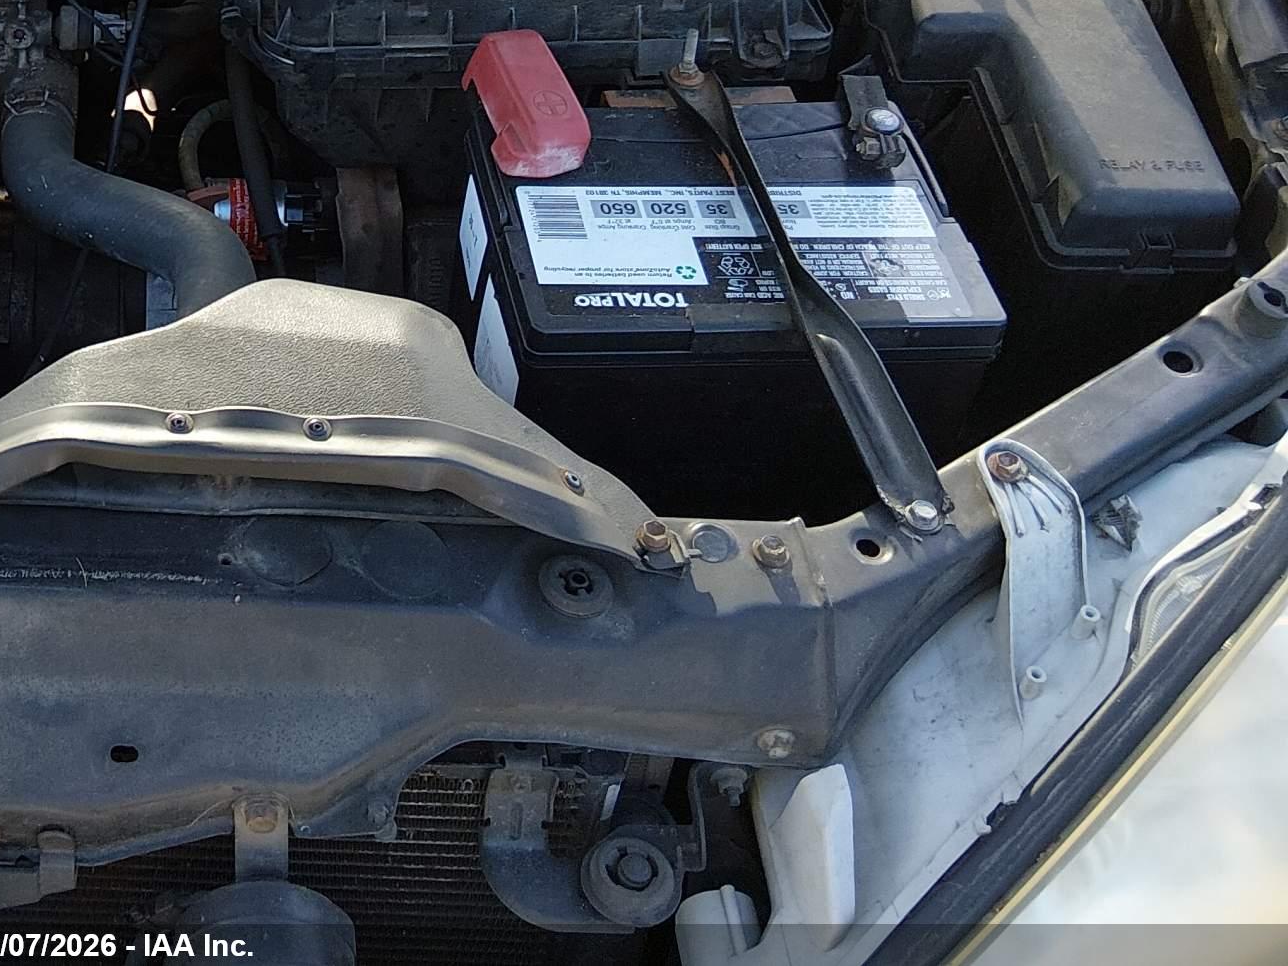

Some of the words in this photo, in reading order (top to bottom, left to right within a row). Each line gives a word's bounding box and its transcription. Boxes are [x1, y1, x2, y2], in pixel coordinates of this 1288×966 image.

[1098, 158, 1145, 171] RELAY
[1166, 160, 1205, 172] FUSE
[599, 203, 635, 215] 650
[650, 203, 687, 215] 520
[706, 203, 727, 215] 35
[574, 292, 688, 307] TOTALPRO
